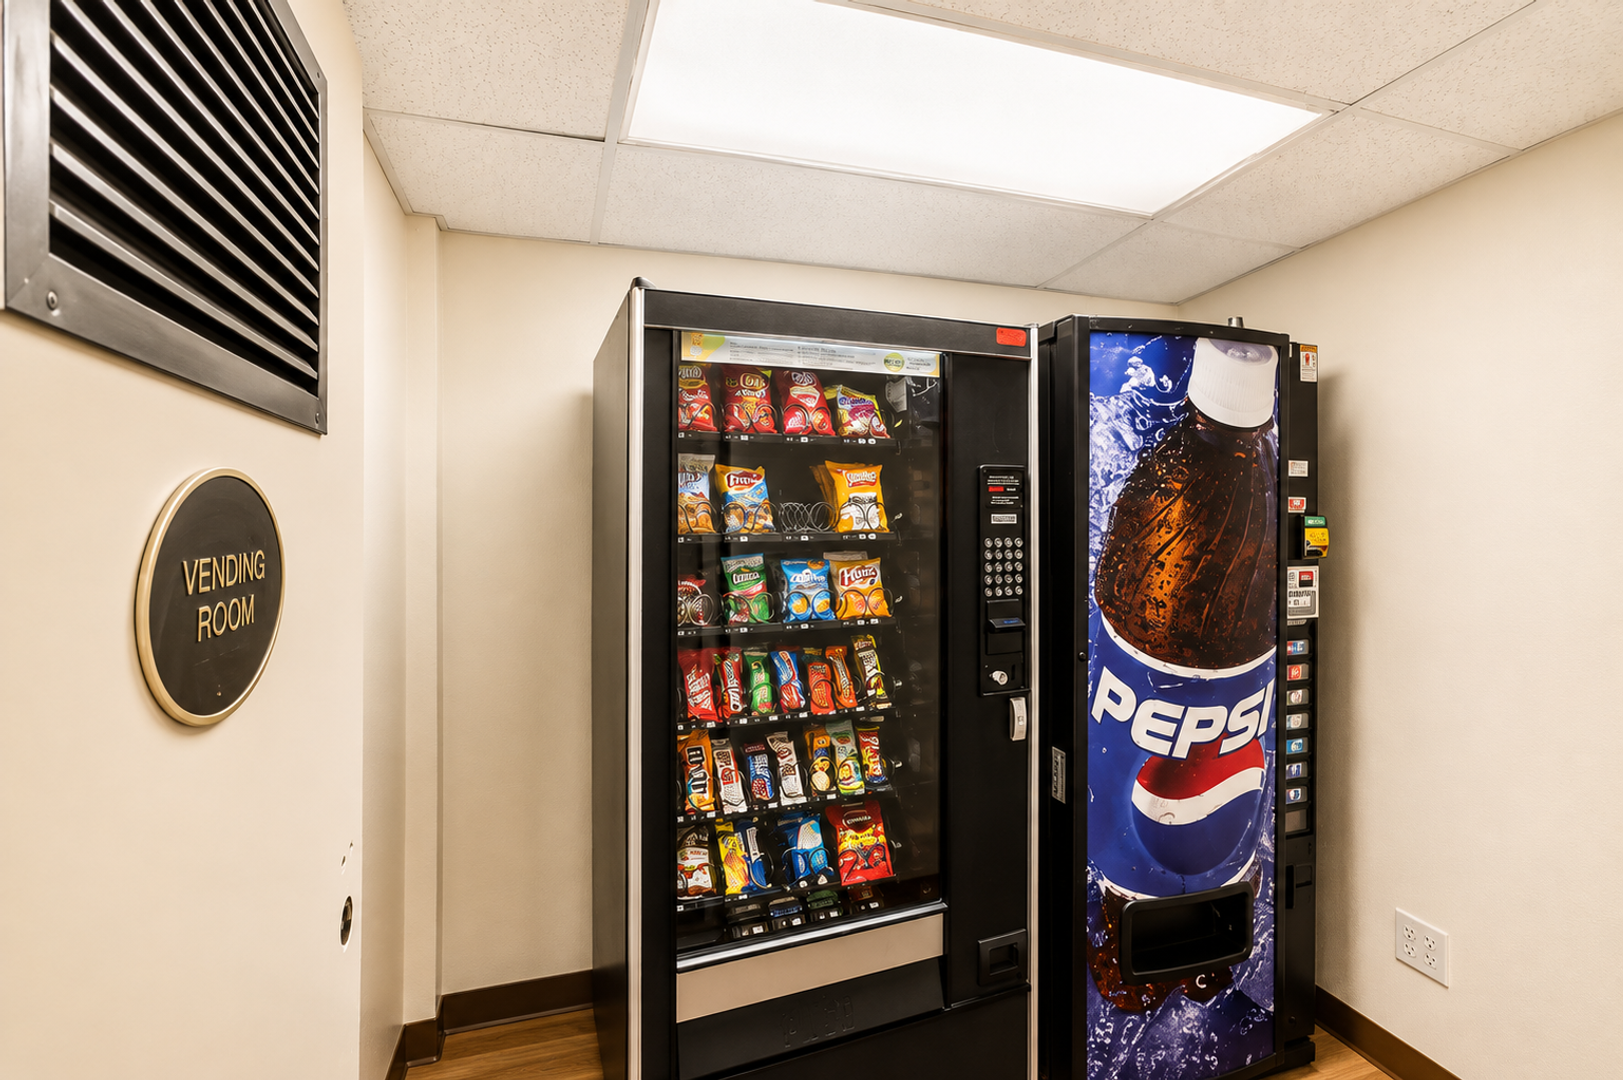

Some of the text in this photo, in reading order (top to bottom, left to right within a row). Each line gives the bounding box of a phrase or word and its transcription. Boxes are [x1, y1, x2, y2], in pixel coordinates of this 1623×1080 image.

[182, 549, 266, 595] VENDING
[197, 593, 255, 642] ROOM
[1091, 665, 1275, 759] PEPSI
